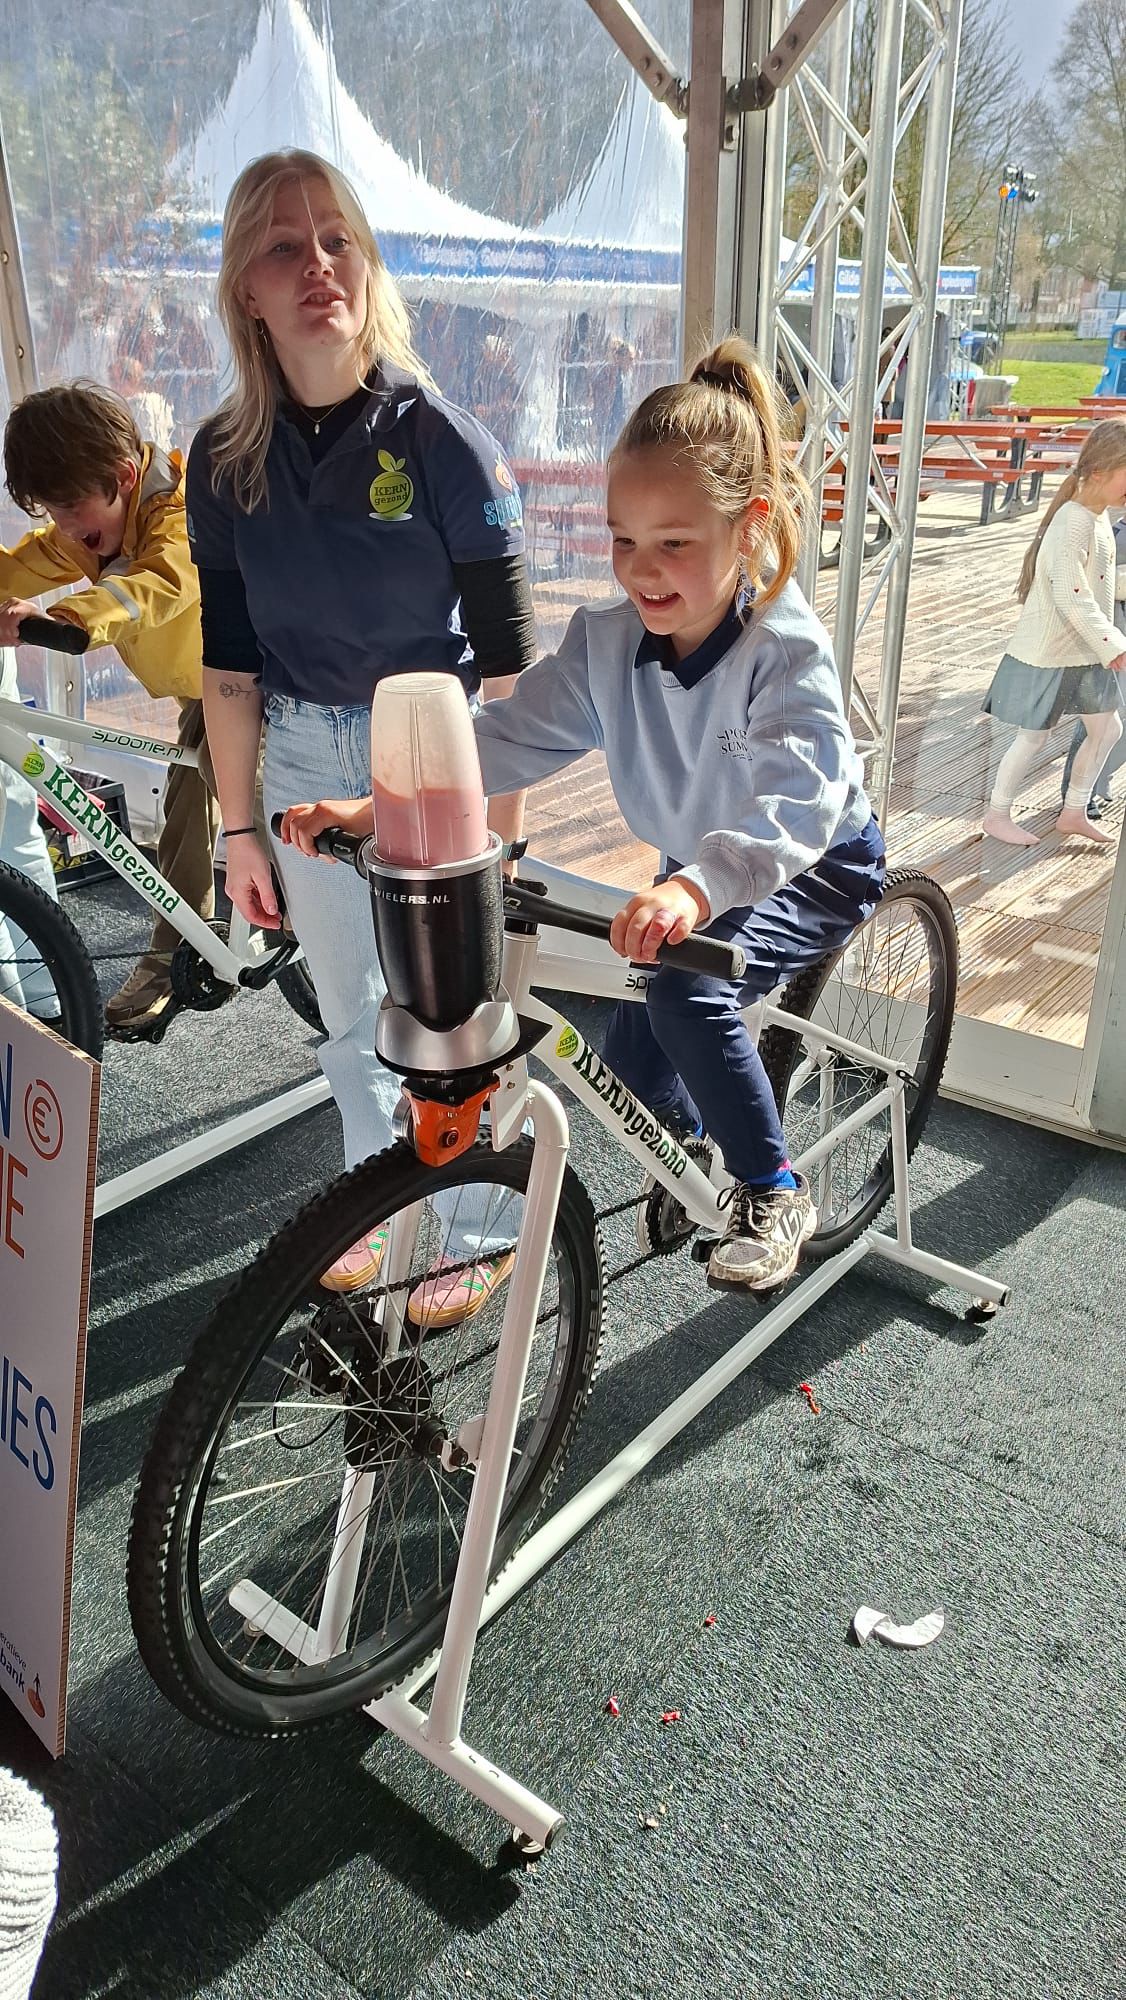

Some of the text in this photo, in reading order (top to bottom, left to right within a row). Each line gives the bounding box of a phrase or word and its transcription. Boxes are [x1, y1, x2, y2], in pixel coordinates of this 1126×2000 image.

[374, 482, 408, 497] KERN
[375, 492, 408, 505] gezond
[44, 765, 181, 914] KERNgezond
[1, 1355, 56, 1491] IES
